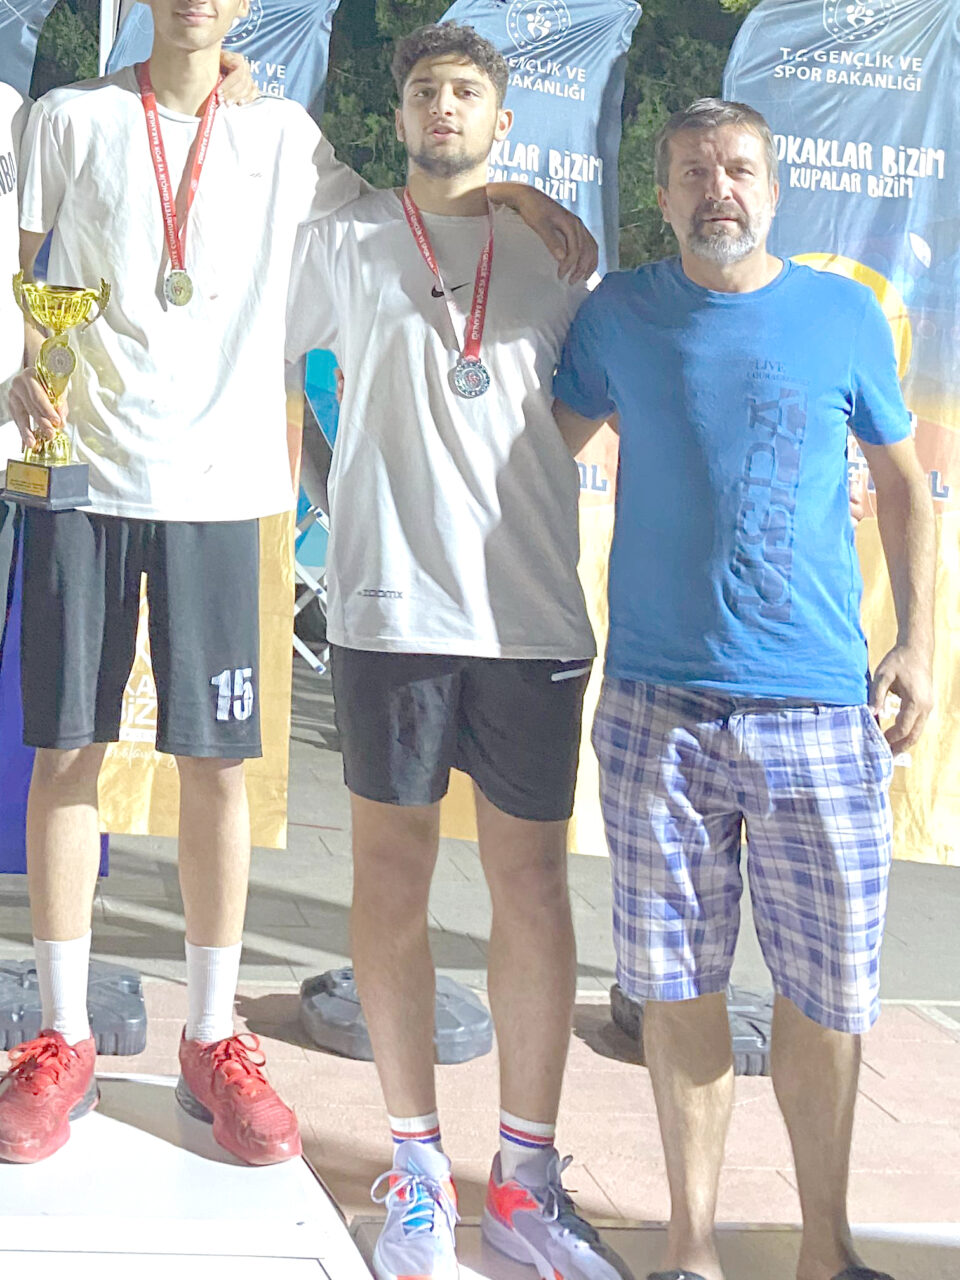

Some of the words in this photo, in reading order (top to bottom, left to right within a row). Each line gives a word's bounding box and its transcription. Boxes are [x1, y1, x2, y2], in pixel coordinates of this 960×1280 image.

[266, 62, 286, 78] VE
[780, 47, 808, 62] T.C.
[814, 50, 894, 70] GENÇLİK
[899, 56, 922, 71] VE
[566, 66, 586, 82] VE
[774, 65, 822, 82] SPOR
[826, 70, 922, 92] BAKANLIĞI
[790, 167, 861, 193] KUPALAR
[211, 668, 254, 720] 15
